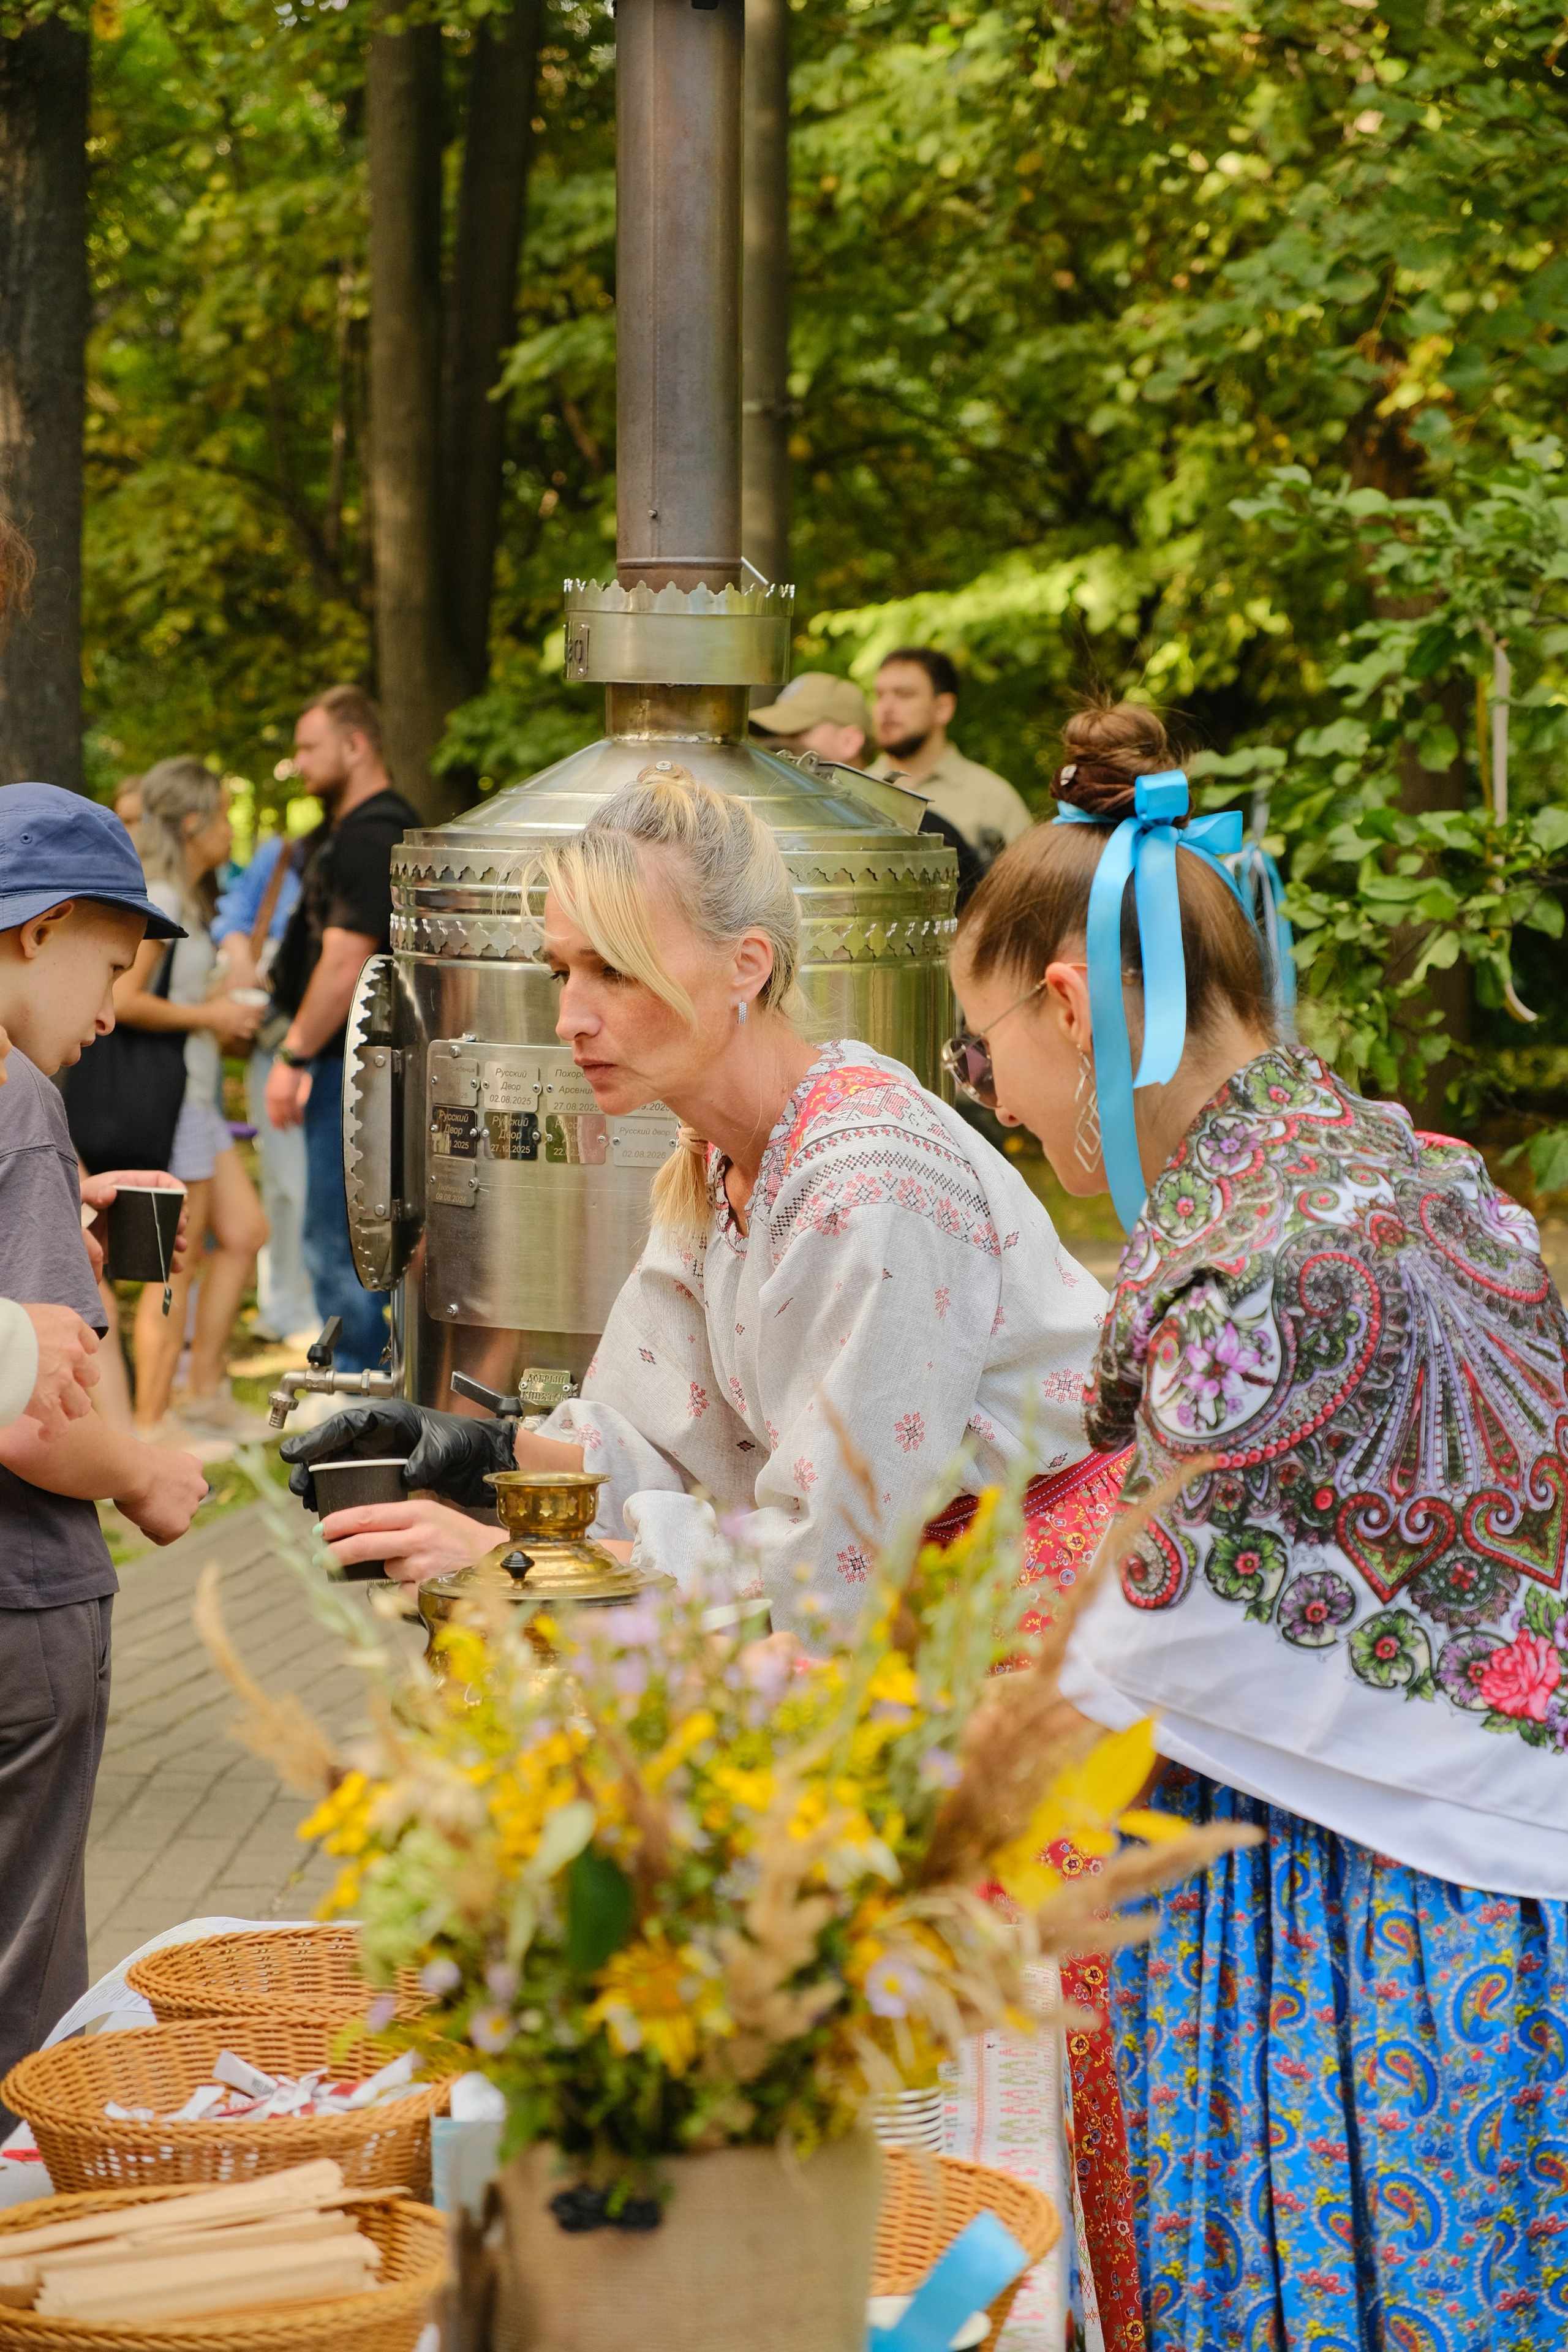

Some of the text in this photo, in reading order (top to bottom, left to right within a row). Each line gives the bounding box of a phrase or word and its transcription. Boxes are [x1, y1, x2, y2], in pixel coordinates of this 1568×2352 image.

[495, 1068, 527, 1078] Русский
[554, 1069, 586, 1079] Похоро
[500, 1081, 521, 1091] Двор
[489, 1094, 531, 1105] 02.08.2025
[553, 1102, 599, 1111] 27.08.2025
[438, 1109, 469, 1123] Русский
[492, 1115, 529, 1128] Русский
[443, 1124, 463, 1137] Двор
[498, 1129, 522, 1141] Двор
[619, 1127, 671, 1137] Русский двор
[491, 1144, 530, 1154] 27.12.2025
[622, 1150, 666, 1159] 02.08.2026
[435, 1192, 467, 1204] 09.08.2026
